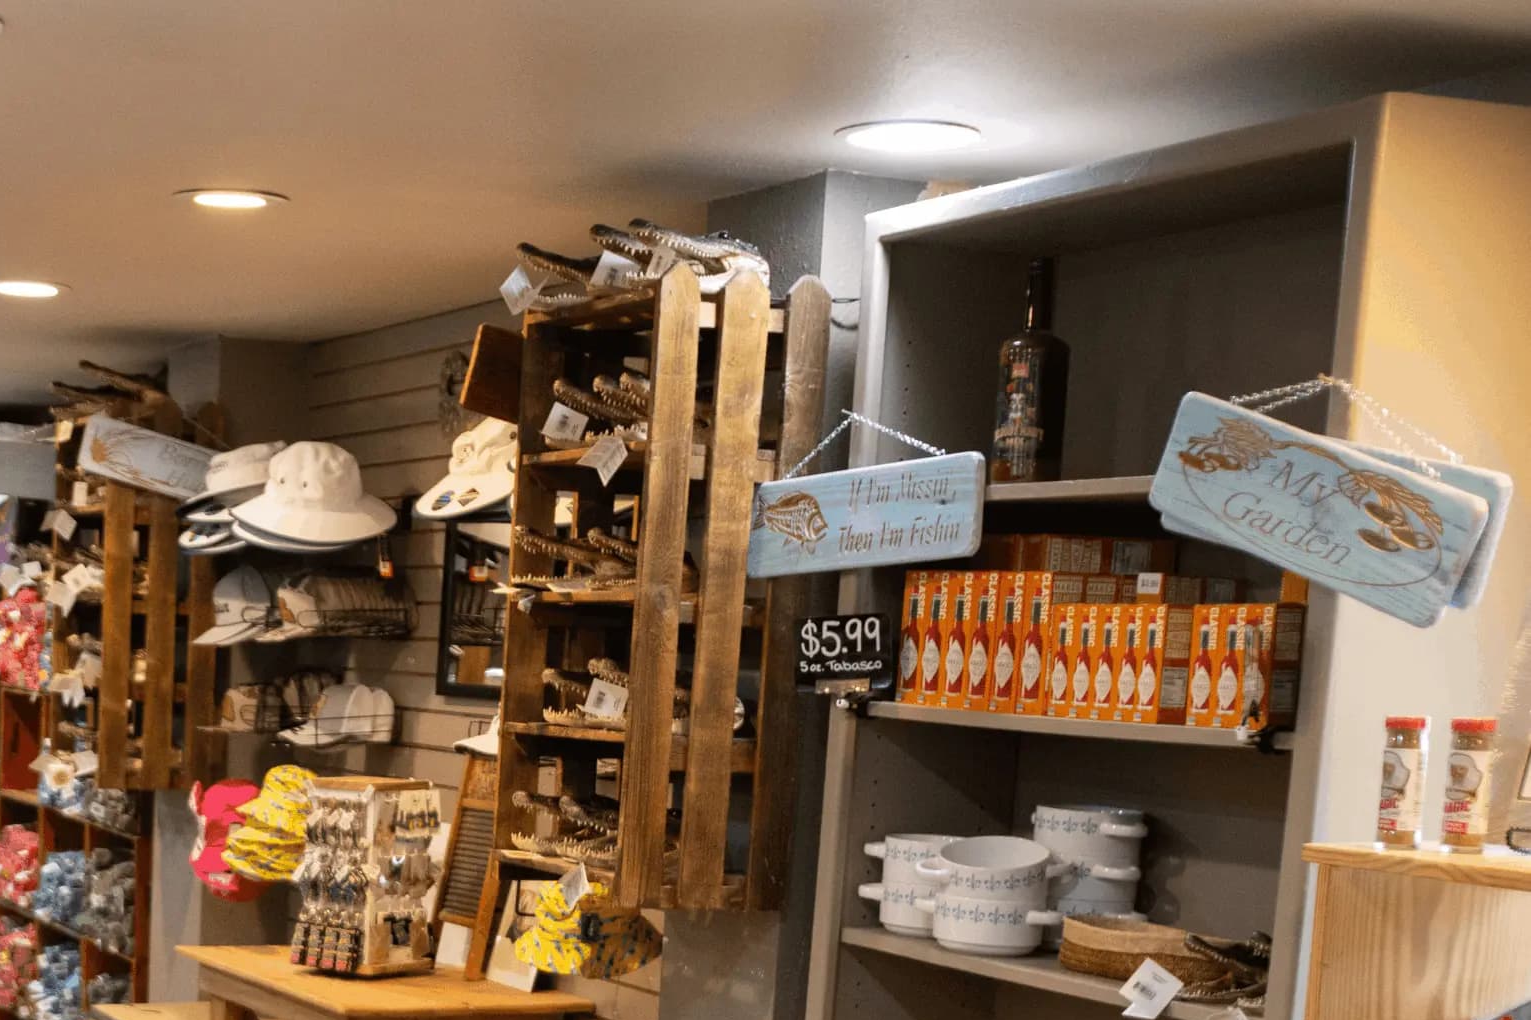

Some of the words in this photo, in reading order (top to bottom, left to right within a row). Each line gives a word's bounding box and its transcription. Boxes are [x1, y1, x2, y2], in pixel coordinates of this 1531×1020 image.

[1268, 459, 1341, 507] My
[838, 525, 873, 554] Then
[1223, 491, 1352, 566] Garden
[800, 616, 881, 658] $5.99
[799, 661, 809, 672] 5
[809, 663, 825, 673] oz.
[825, 660, 883, 672] Tabasco
